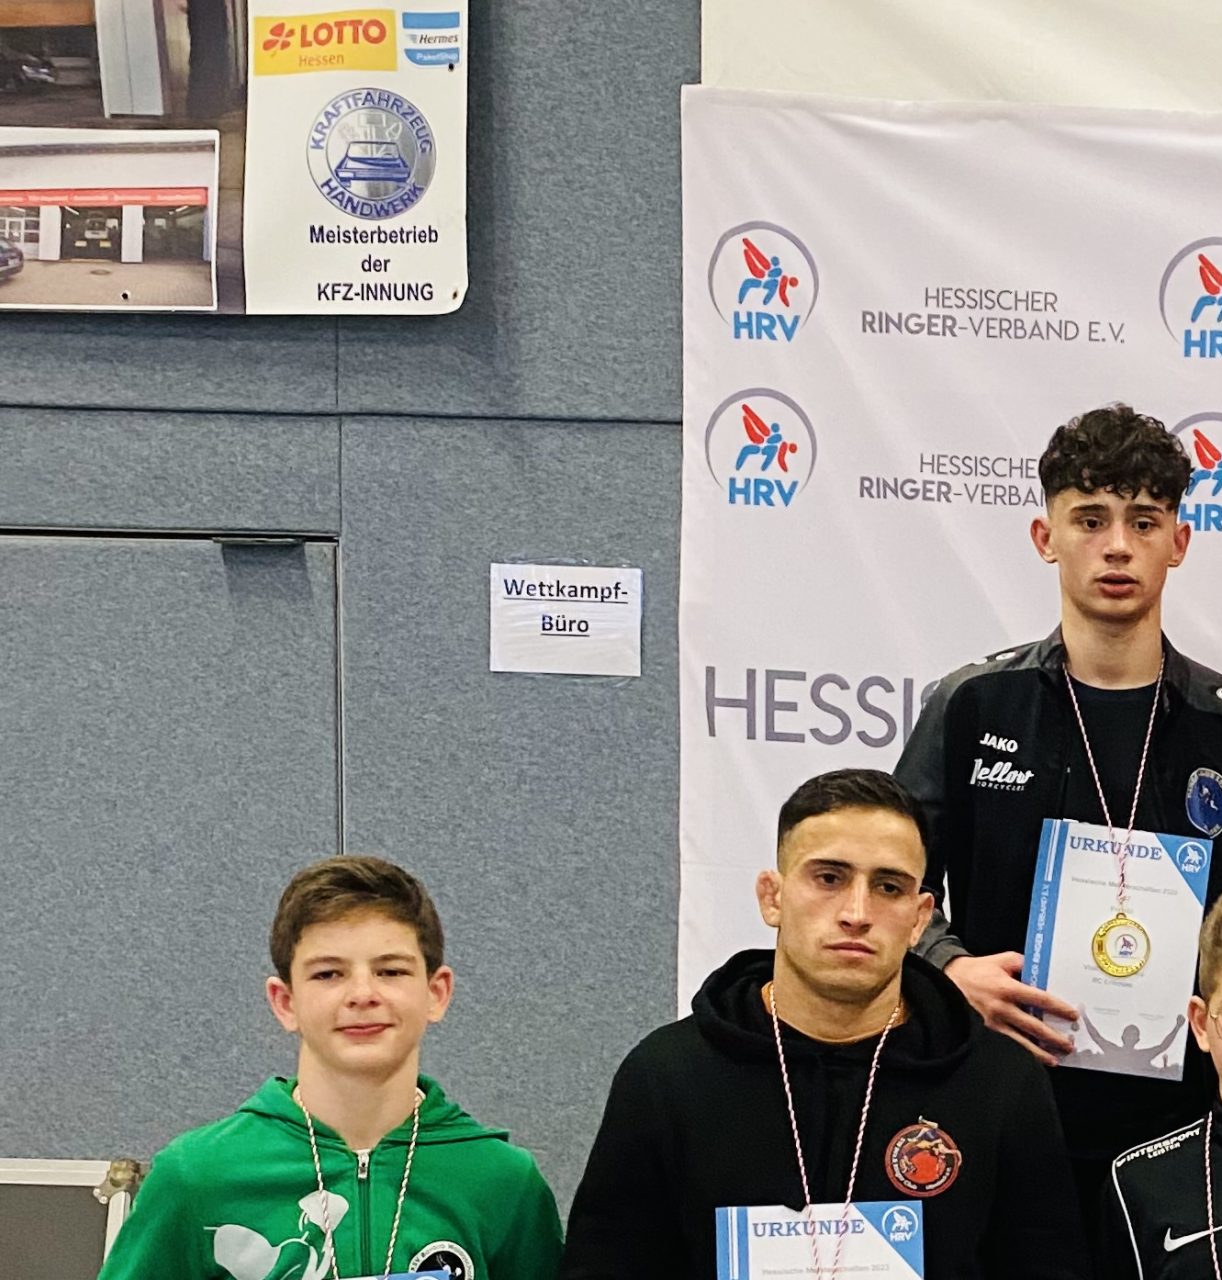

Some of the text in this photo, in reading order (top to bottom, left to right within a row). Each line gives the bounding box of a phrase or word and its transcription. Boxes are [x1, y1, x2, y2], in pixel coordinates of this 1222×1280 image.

[300, 19, 386, 47] LOTTO
[418, 33, 458, 45] Hermes
[298, 54, 344, 67] Hessen
[310, 91, 432, 153] KRAFTFAHRZEUG
[320, 178, 424, 218] HANDWERK
[309, 225, 438, 244] Meisterbetrieb
[361, 255, 390, 272] der
[317, 283, 433, 301] KFZ-INNUNG
[924, 287, 1057, 313] HESSISCHER
[733, 311, 800, 342] HRV
[861, 310, 1079, 342] RINGER-VERBAND
[919, 454, 1039, 480] HESSISCHE
[727, 477, 799, 507] HRV
[859, 478, 1044, 508] RINGER-VERBA
[503, 578, 629, 603] Wettkampf-
[541, 614, 590, 633] Büro
[980, 732, 1018, 753] JAKO
[1069, 835, 1162, 861] URKUNDE
[1126, 1127, 1200, 1162] INTERSPORT
[752, 1218, 865, 1238] URKUNDE
[889, 1230, 912, 1242] HRV
